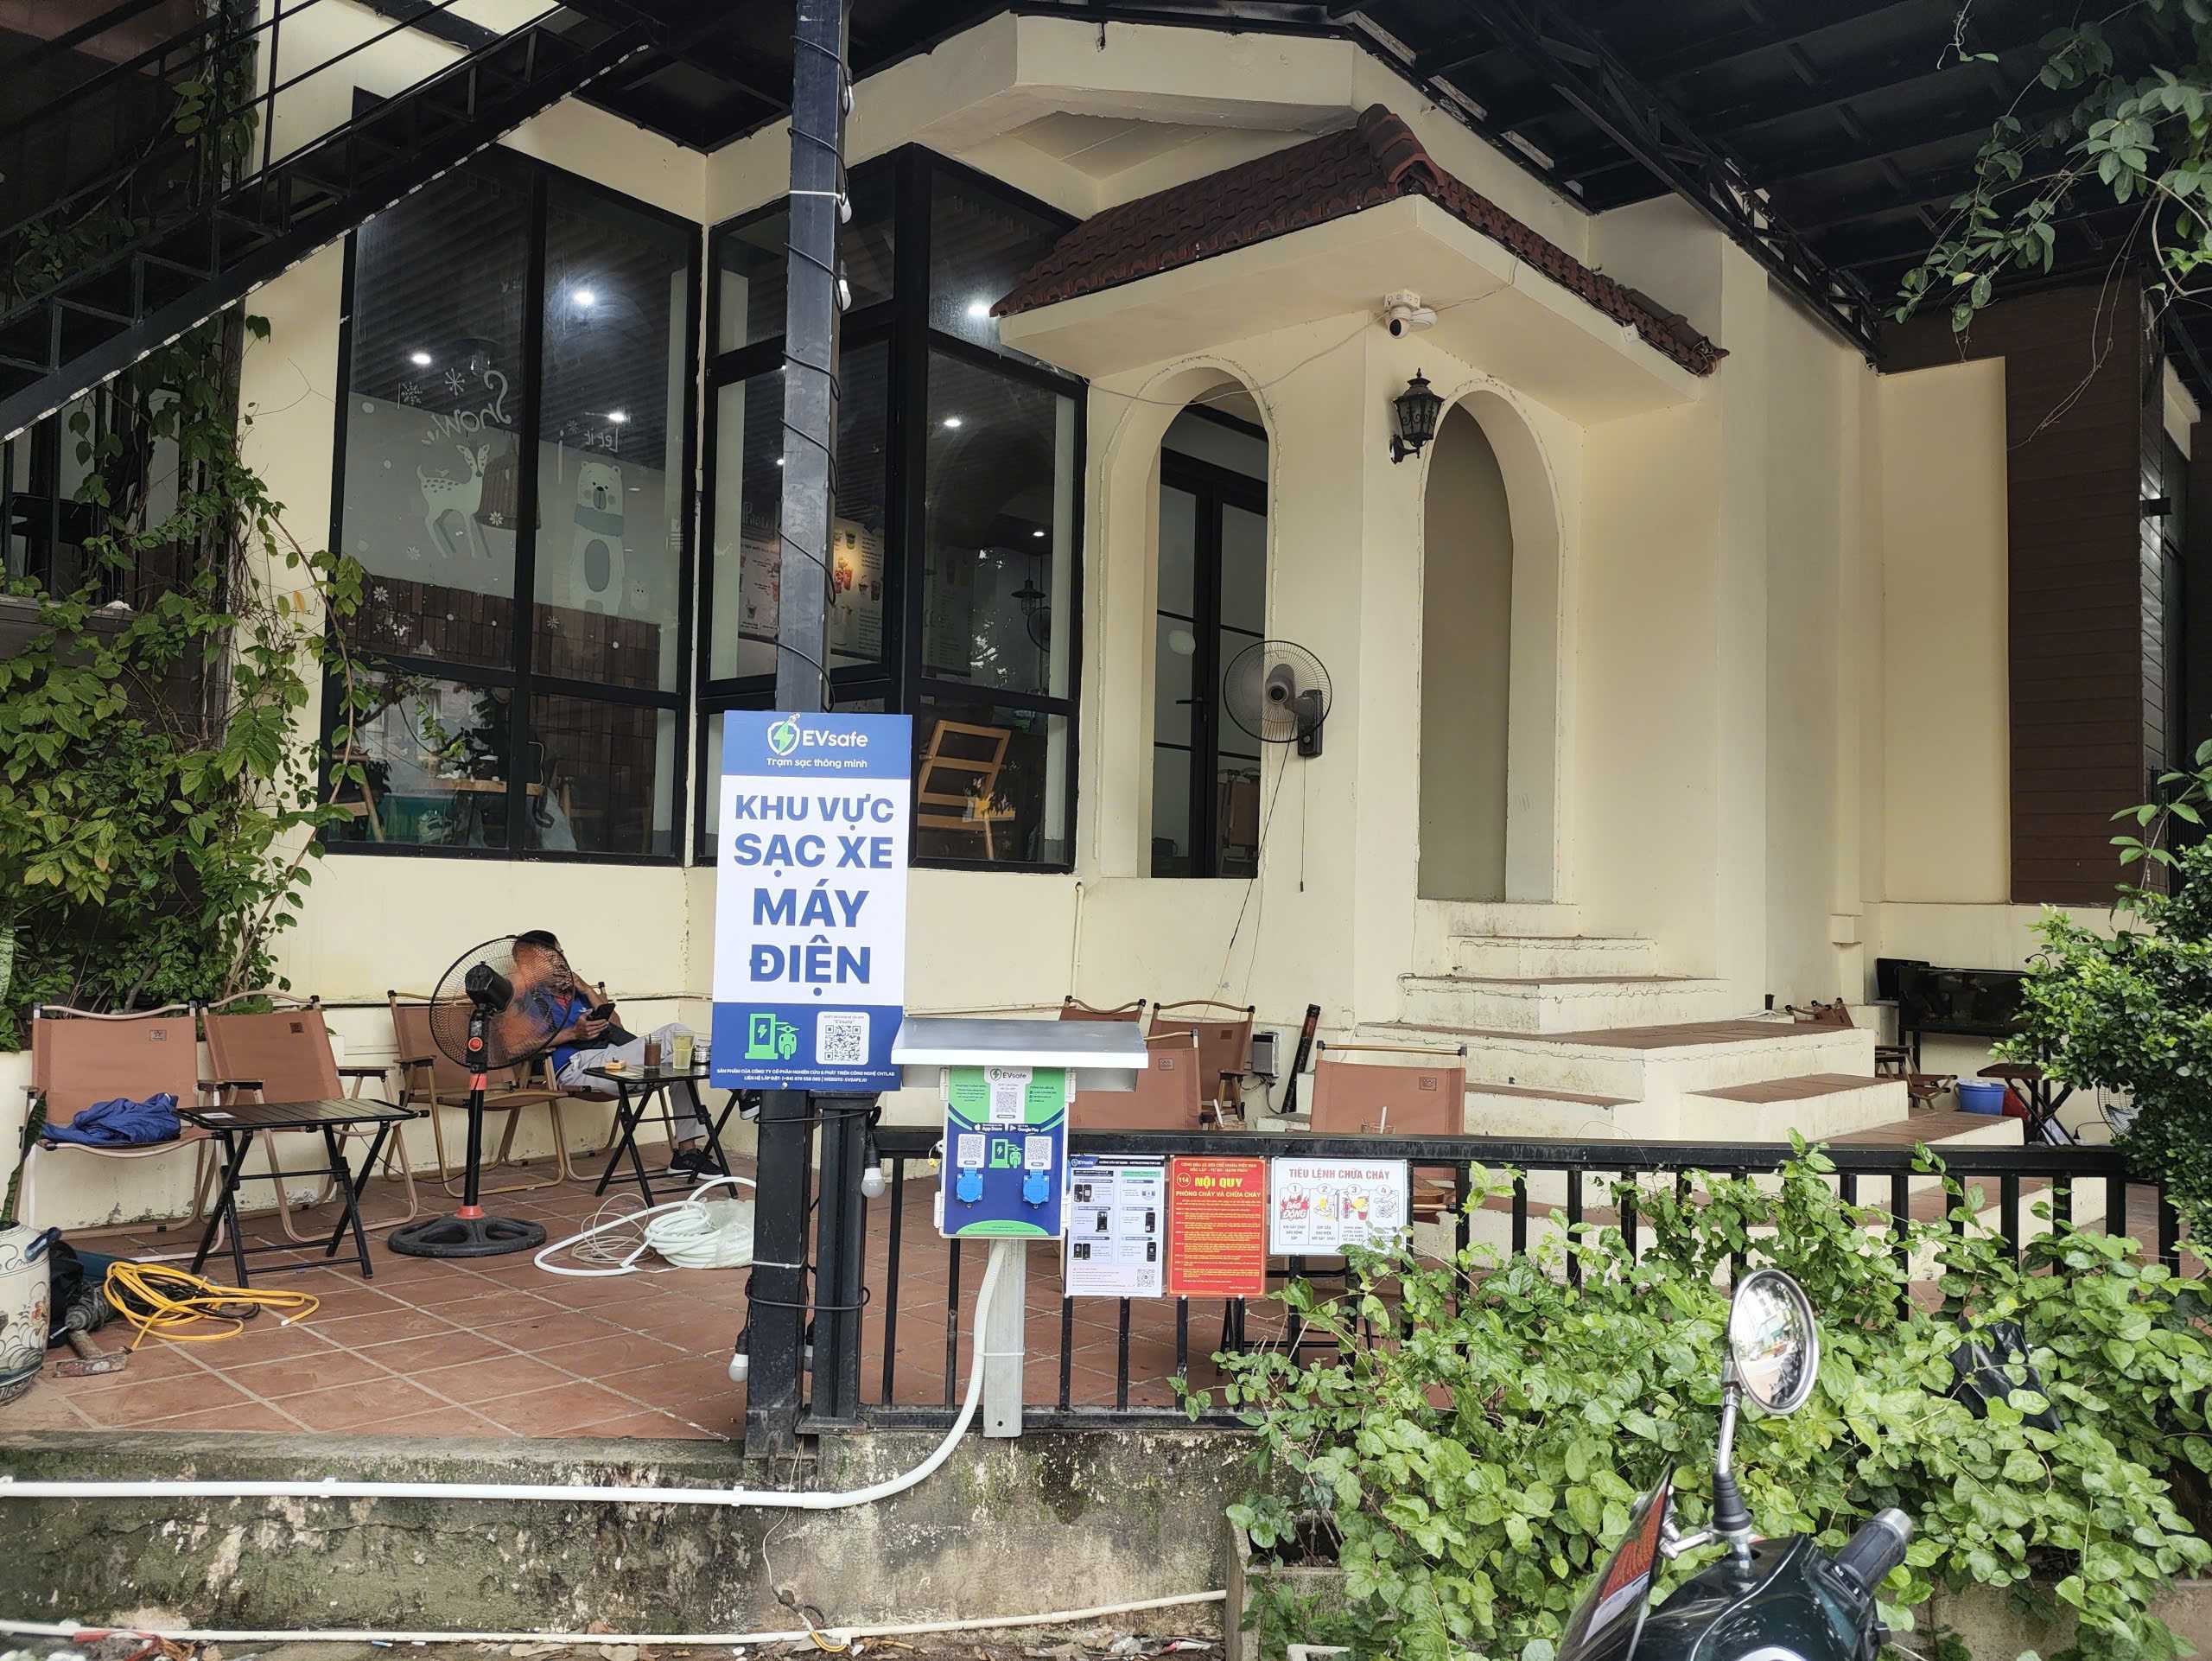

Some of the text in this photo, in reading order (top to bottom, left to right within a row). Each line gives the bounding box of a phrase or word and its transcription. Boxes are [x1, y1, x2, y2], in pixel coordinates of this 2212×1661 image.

[802, 729, 868, 748] EVsafe
[766, 757, 868, 769] Trạm sạc thông minh
[734, 793, 894, 831] KHU VỰC
[734, 833, 893, 878] SẠC XE
[753, 878, 870, 928] MÁY
[749, 934, 871, 997] ĐIỆN
[1194, 1175, 1243, 1188] NỘI QUY
[1289, 1168, 1390, 1181] TIÊU LỆNH CHỮA CHÁY
